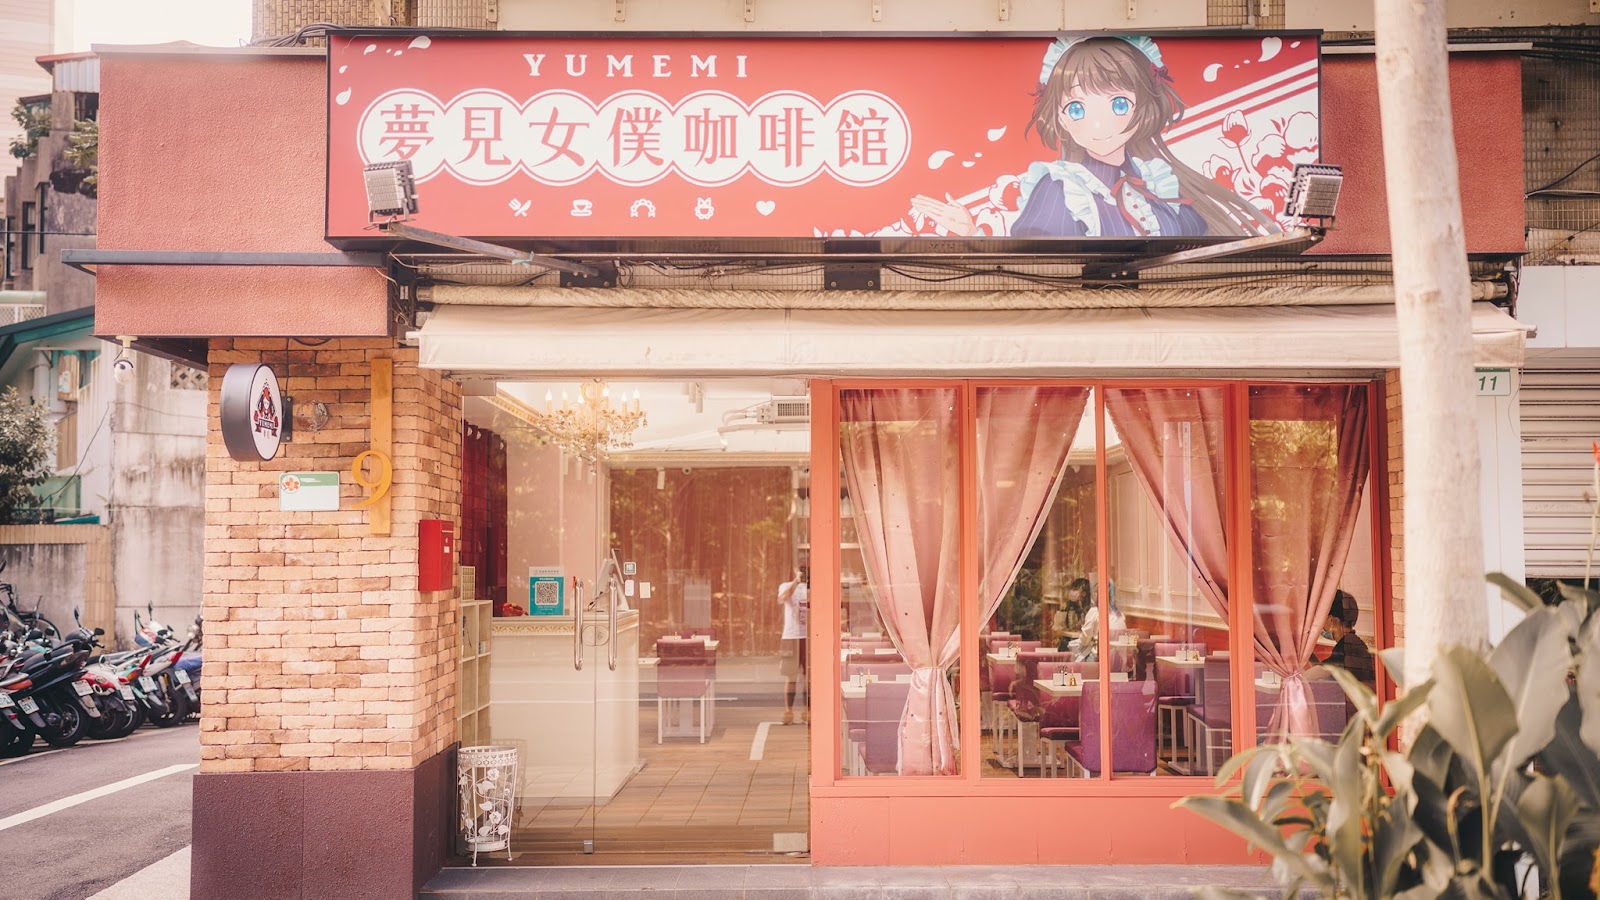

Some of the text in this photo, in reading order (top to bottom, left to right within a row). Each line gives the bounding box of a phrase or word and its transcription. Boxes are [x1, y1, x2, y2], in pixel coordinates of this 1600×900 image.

[523, 53, 748, 78] YUMEMI
[378, 103, 889, 168] 夢見女僕咖啡館
[1478, 375, 1498, 391] 11
[351, 449, 393, 509] 9
